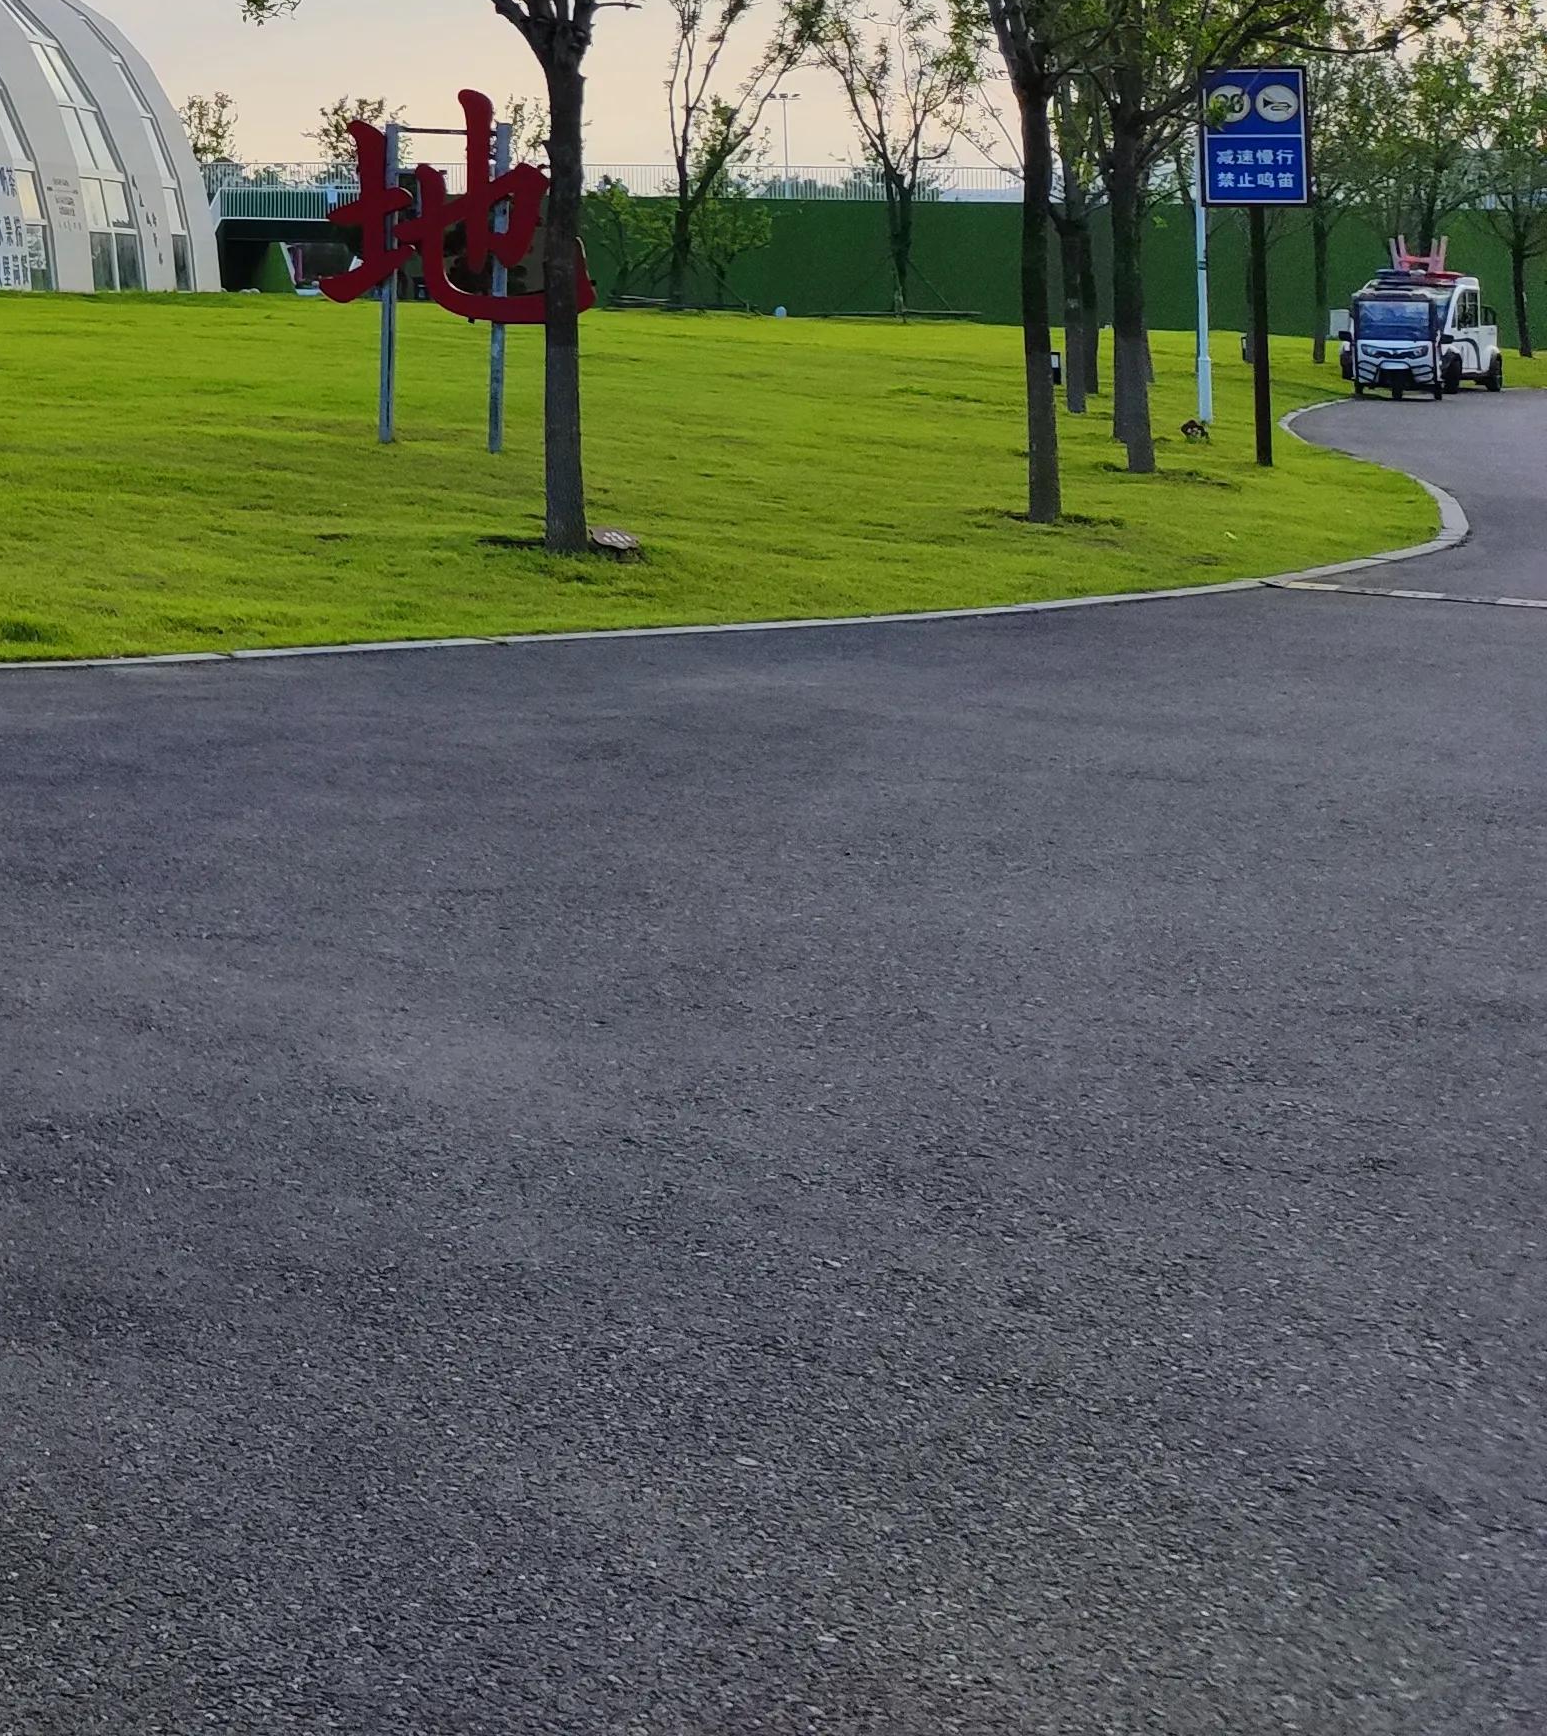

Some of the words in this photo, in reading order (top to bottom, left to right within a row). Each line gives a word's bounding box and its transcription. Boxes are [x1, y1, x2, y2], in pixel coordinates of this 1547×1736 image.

[1216, 149, 1295, 165] 减速慢行
[1217, 171, 1295, 188] 禁止鸣笛
[318, 89, 596, 324] 地
